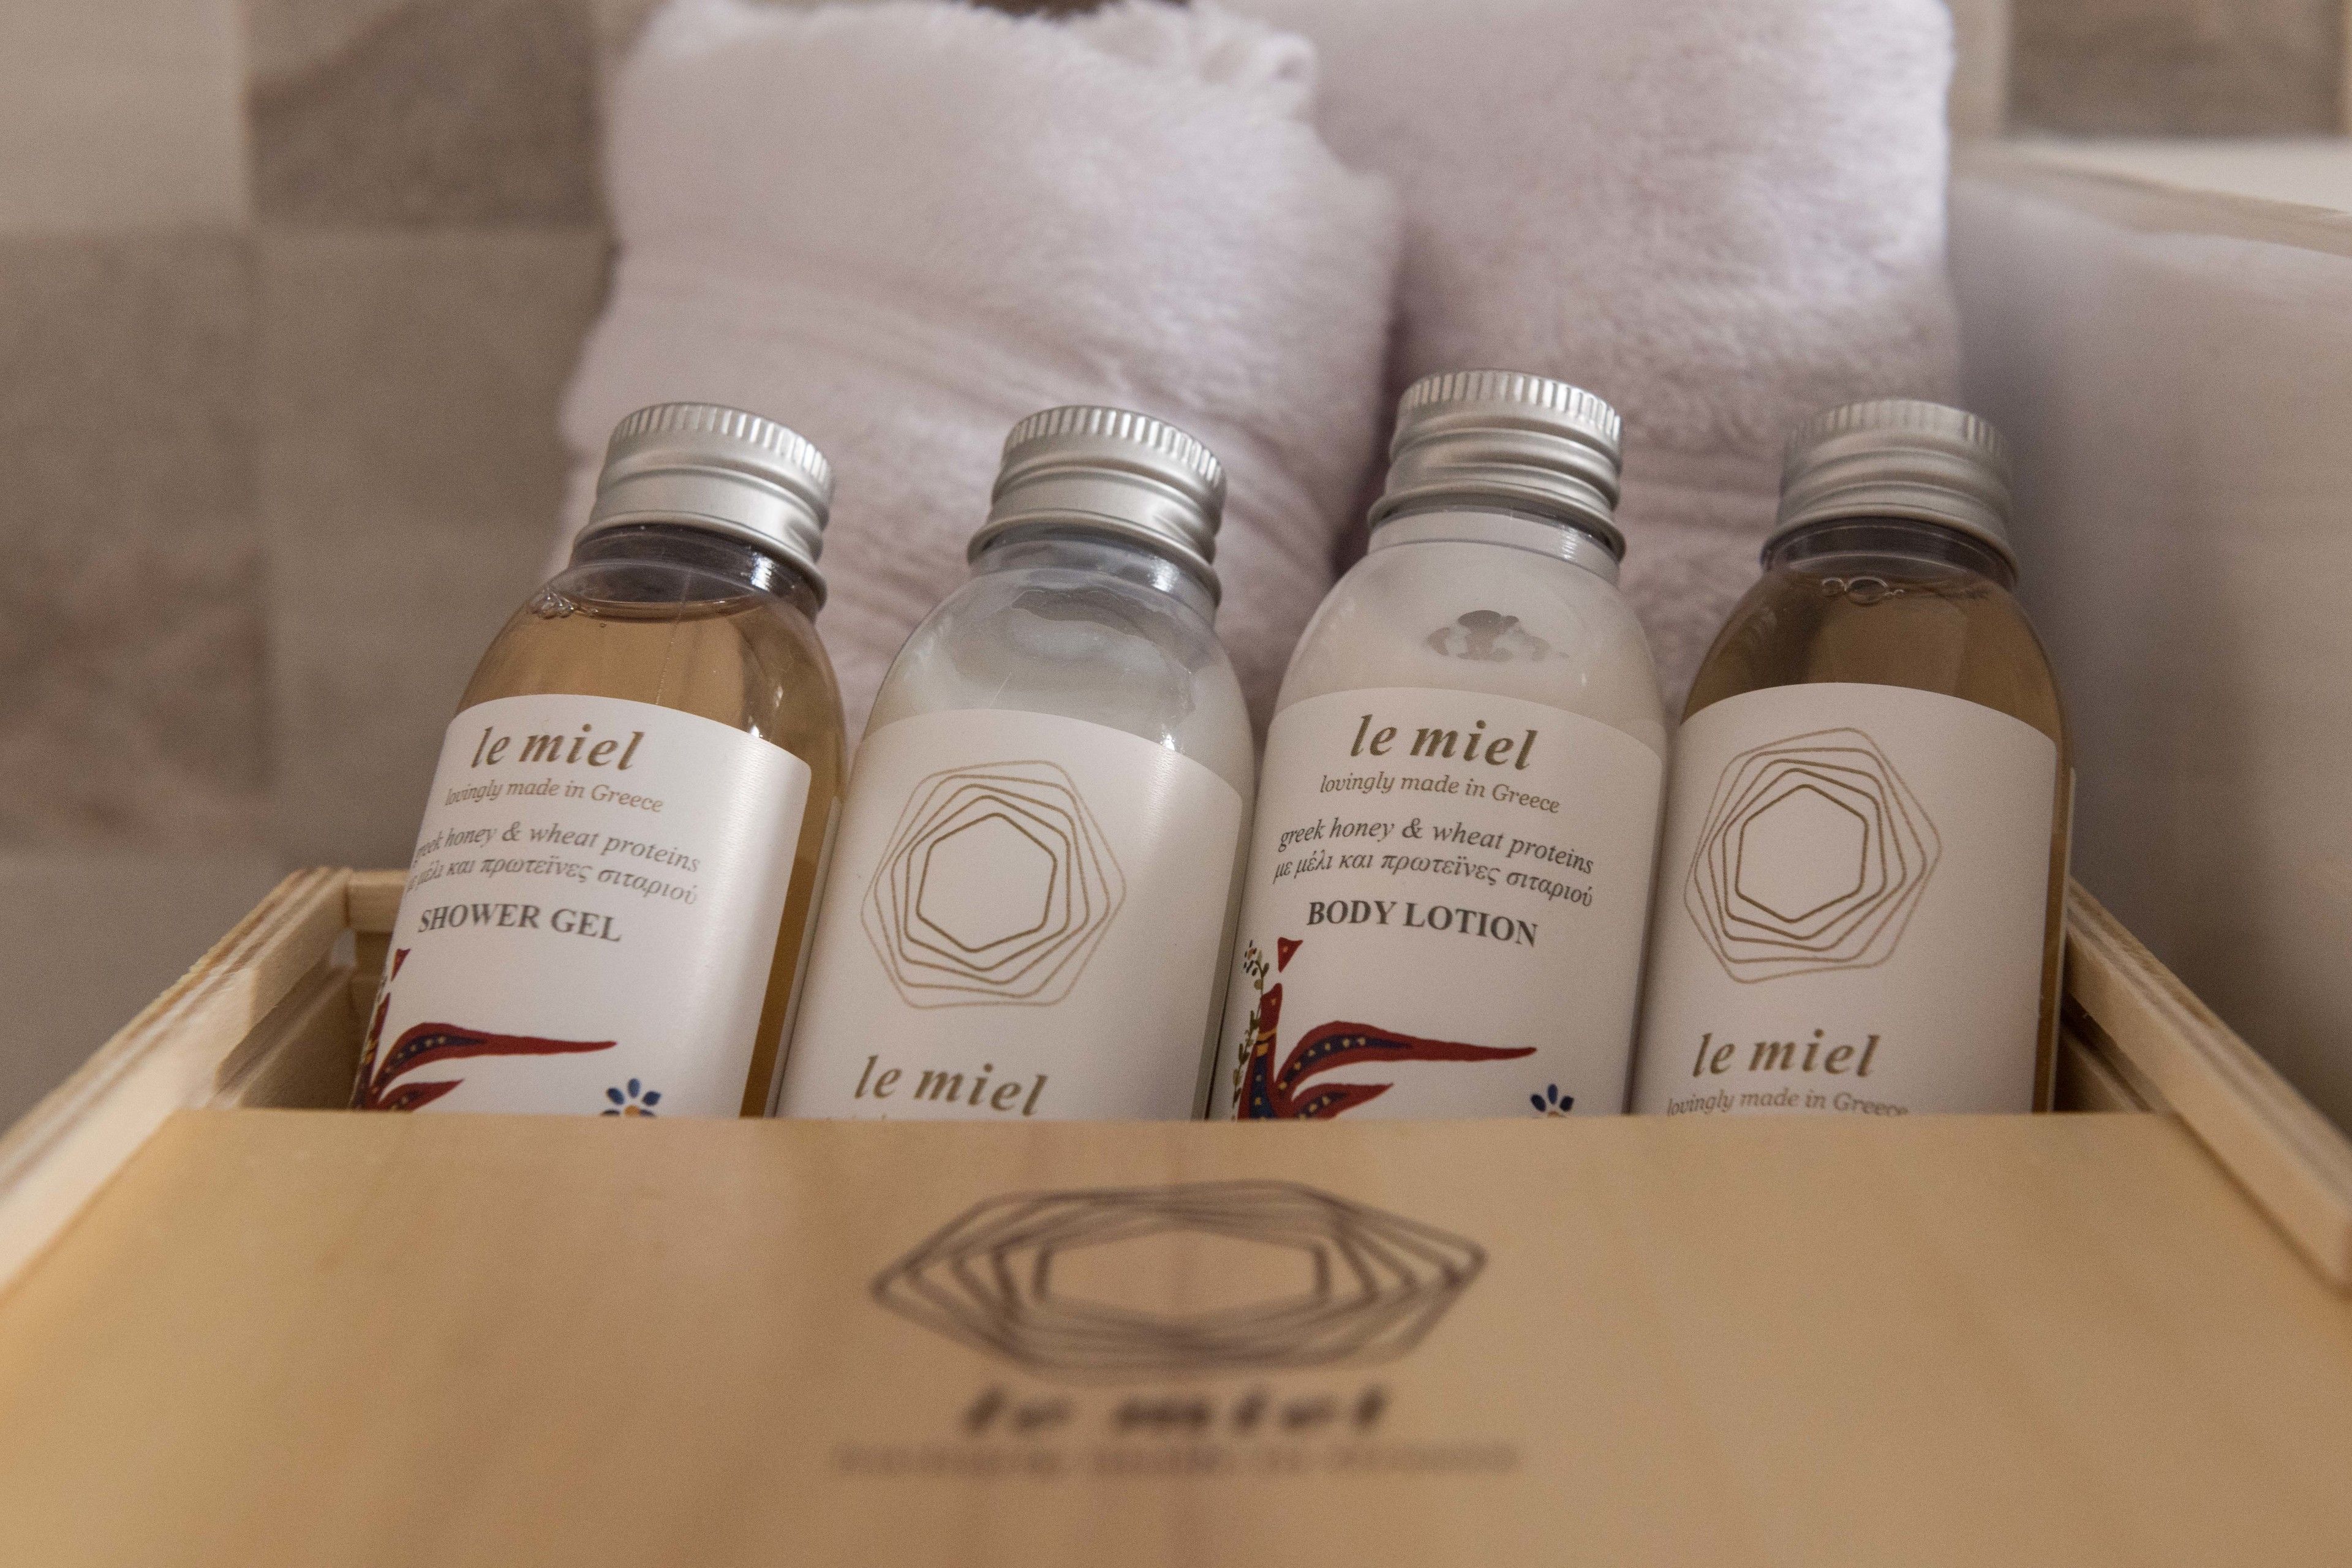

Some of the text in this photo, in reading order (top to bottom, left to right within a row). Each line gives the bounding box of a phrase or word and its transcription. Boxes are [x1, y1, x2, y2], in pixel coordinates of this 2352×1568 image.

[471, 723, 646, 770] le miel
[1350, 714, 1539, 771] le miel
[444, 778, 664, 813] lovingly made in Greece
[1319, 771, 1560, 814] lovingly made in Greece
[444, 827, 497, 848] honey
[501, 821, 521, 842] &
[529, 823, 600, 848] wheat
[603, 836, 701, 873] proteins
[1278, 815, 1594, 875] greek honey & wheat proteins
[447, 860, 475, 876] και
[598, 869, 697, 905] σιταριού
[1273, 861, 1293, 884] με
[1294, 850, 1333, 880] μέλι
[1339, 855, 1373, 869] και
[1506, 872, 1593, 907] σιταριού
[417, 903, 623, 943] SHOWER GEL
[1306, 900, 1539, 948] BODY LOTION
[1692, 1028, 1880, 1077] le miel
[854, 1054, 1048, 1117] le miel
[1666, 1089, 1734, 1117] lovingly
[1740, 1087, 1799, 1107] made
[1806, 1090, 1826, 1109] in
